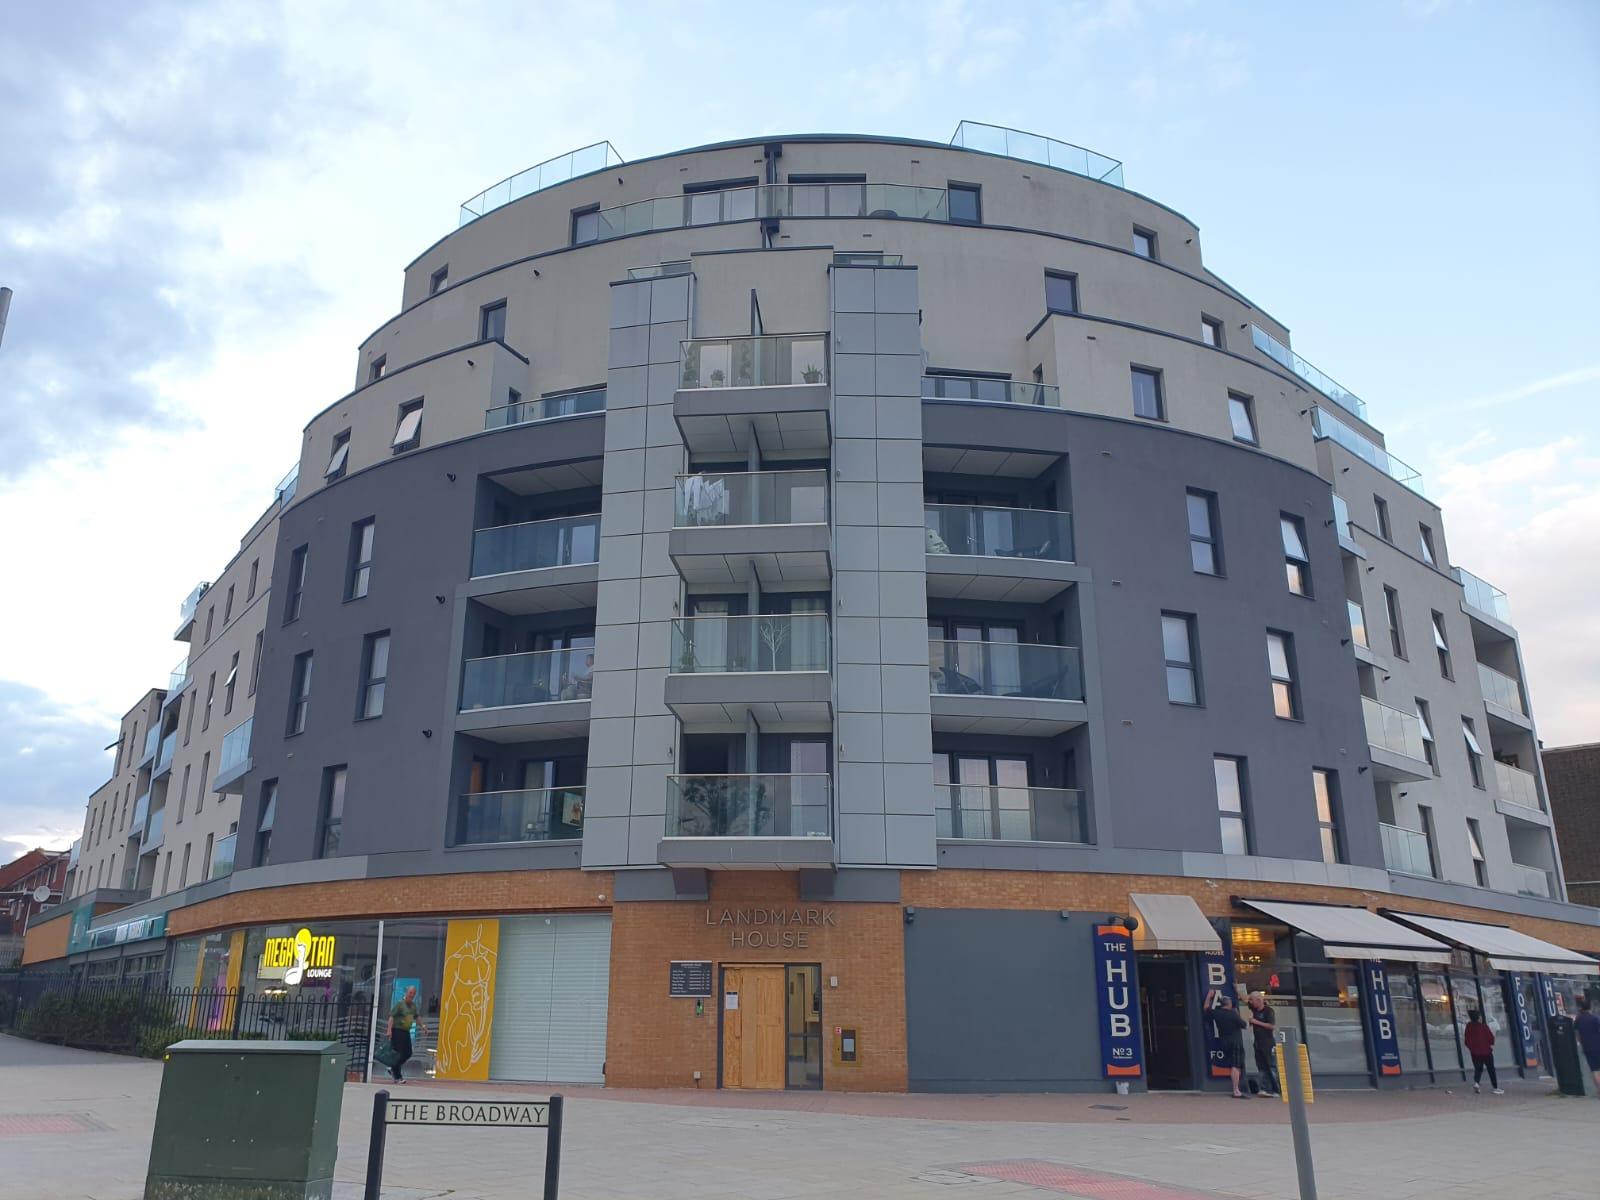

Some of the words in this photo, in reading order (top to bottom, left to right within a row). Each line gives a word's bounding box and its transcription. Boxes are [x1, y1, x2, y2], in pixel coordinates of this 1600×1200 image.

[706, 908, 837, 926] LANDMARK
[731, 930, 809, 948] HOUSE
[1103, 942, 1127, 952] THE
[264, 937, 294, 967] MEGA
[311, 935, 335, 967] TAN
[307, 968, 332, 978] LOUNGE
[1106, 960, 1131, 1037] HUB
[1371, 970, 1392, 1040] HUB
[1515, 977, 1531, 1041] FOOD
[391, 1104, 429, 1121] THE
[436, 1105, 545, 1123] BROADWAY
